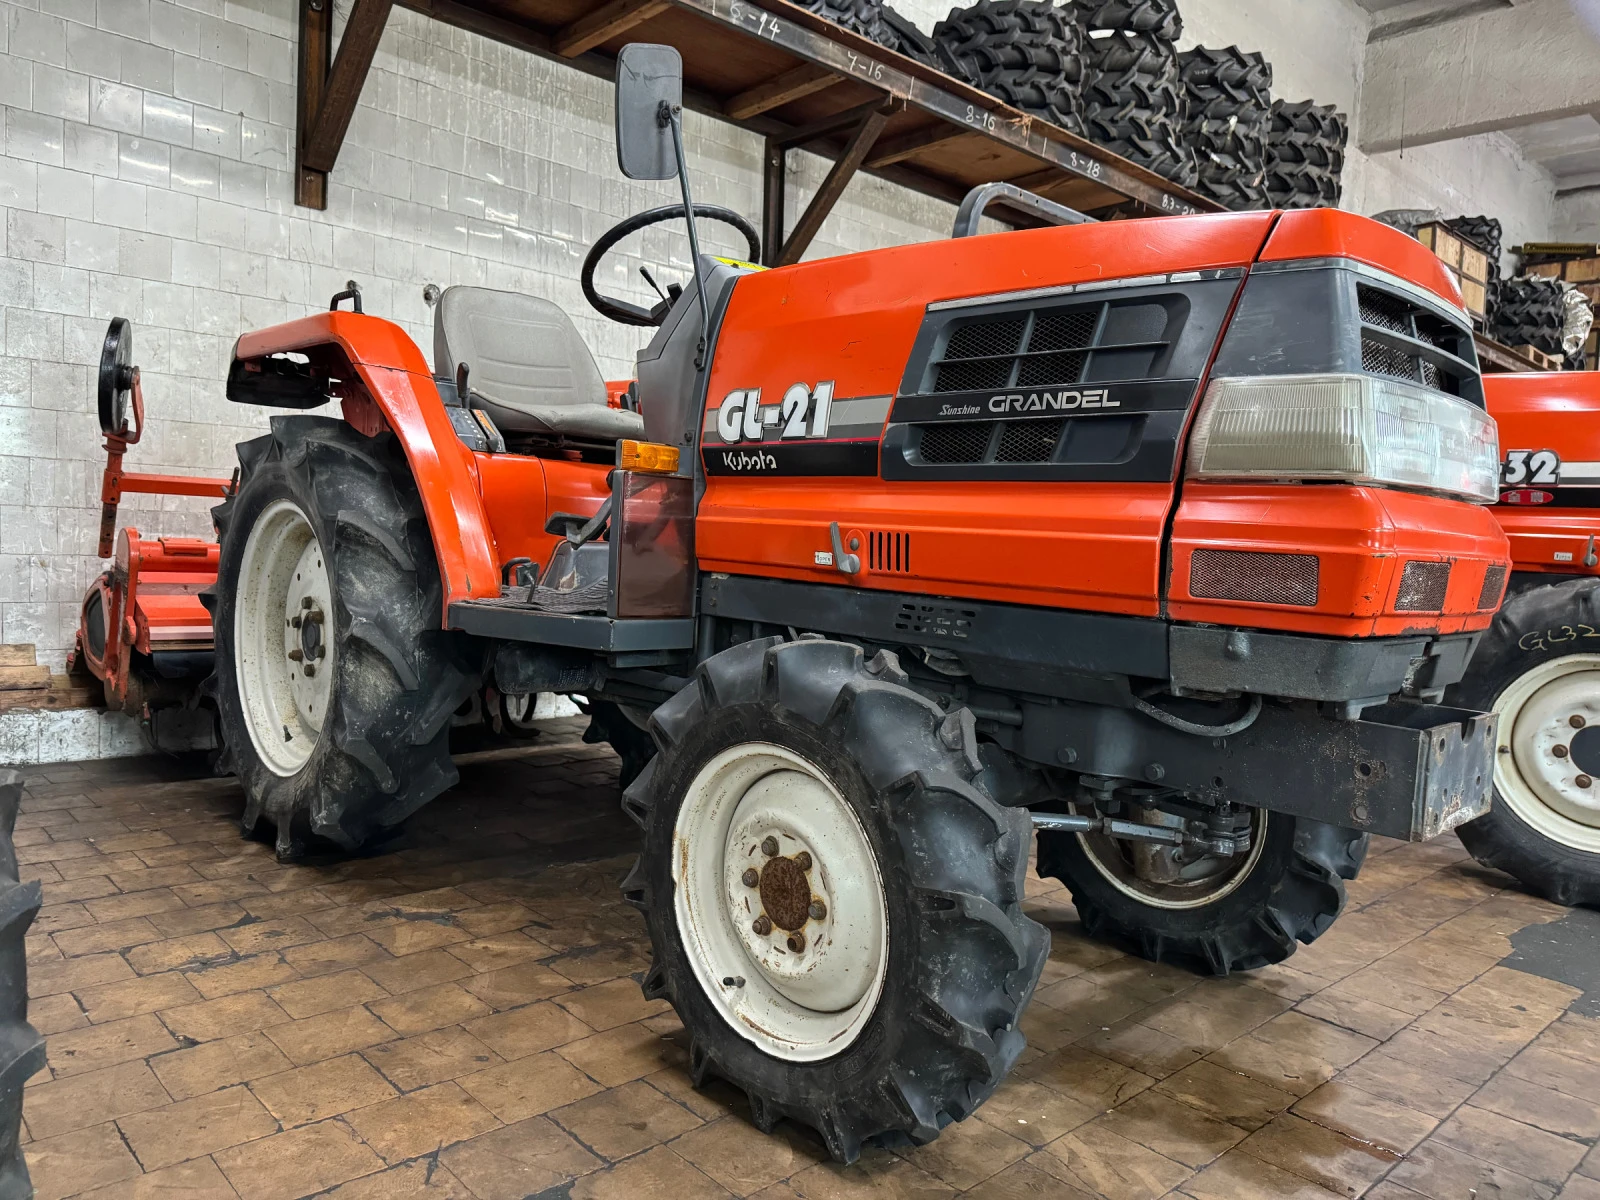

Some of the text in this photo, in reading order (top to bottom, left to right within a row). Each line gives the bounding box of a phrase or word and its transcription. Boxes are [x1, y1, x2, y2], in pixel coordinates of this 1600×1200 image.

[965, 105, 996, 130] 8-16
[1069, 151, 1101, 178] 8-18
[717, 380, 835, 444] GL-21
[938, 389, 1121, 416] Sunshine GRANDEL
[723, 450, 777, 471] Kubota
